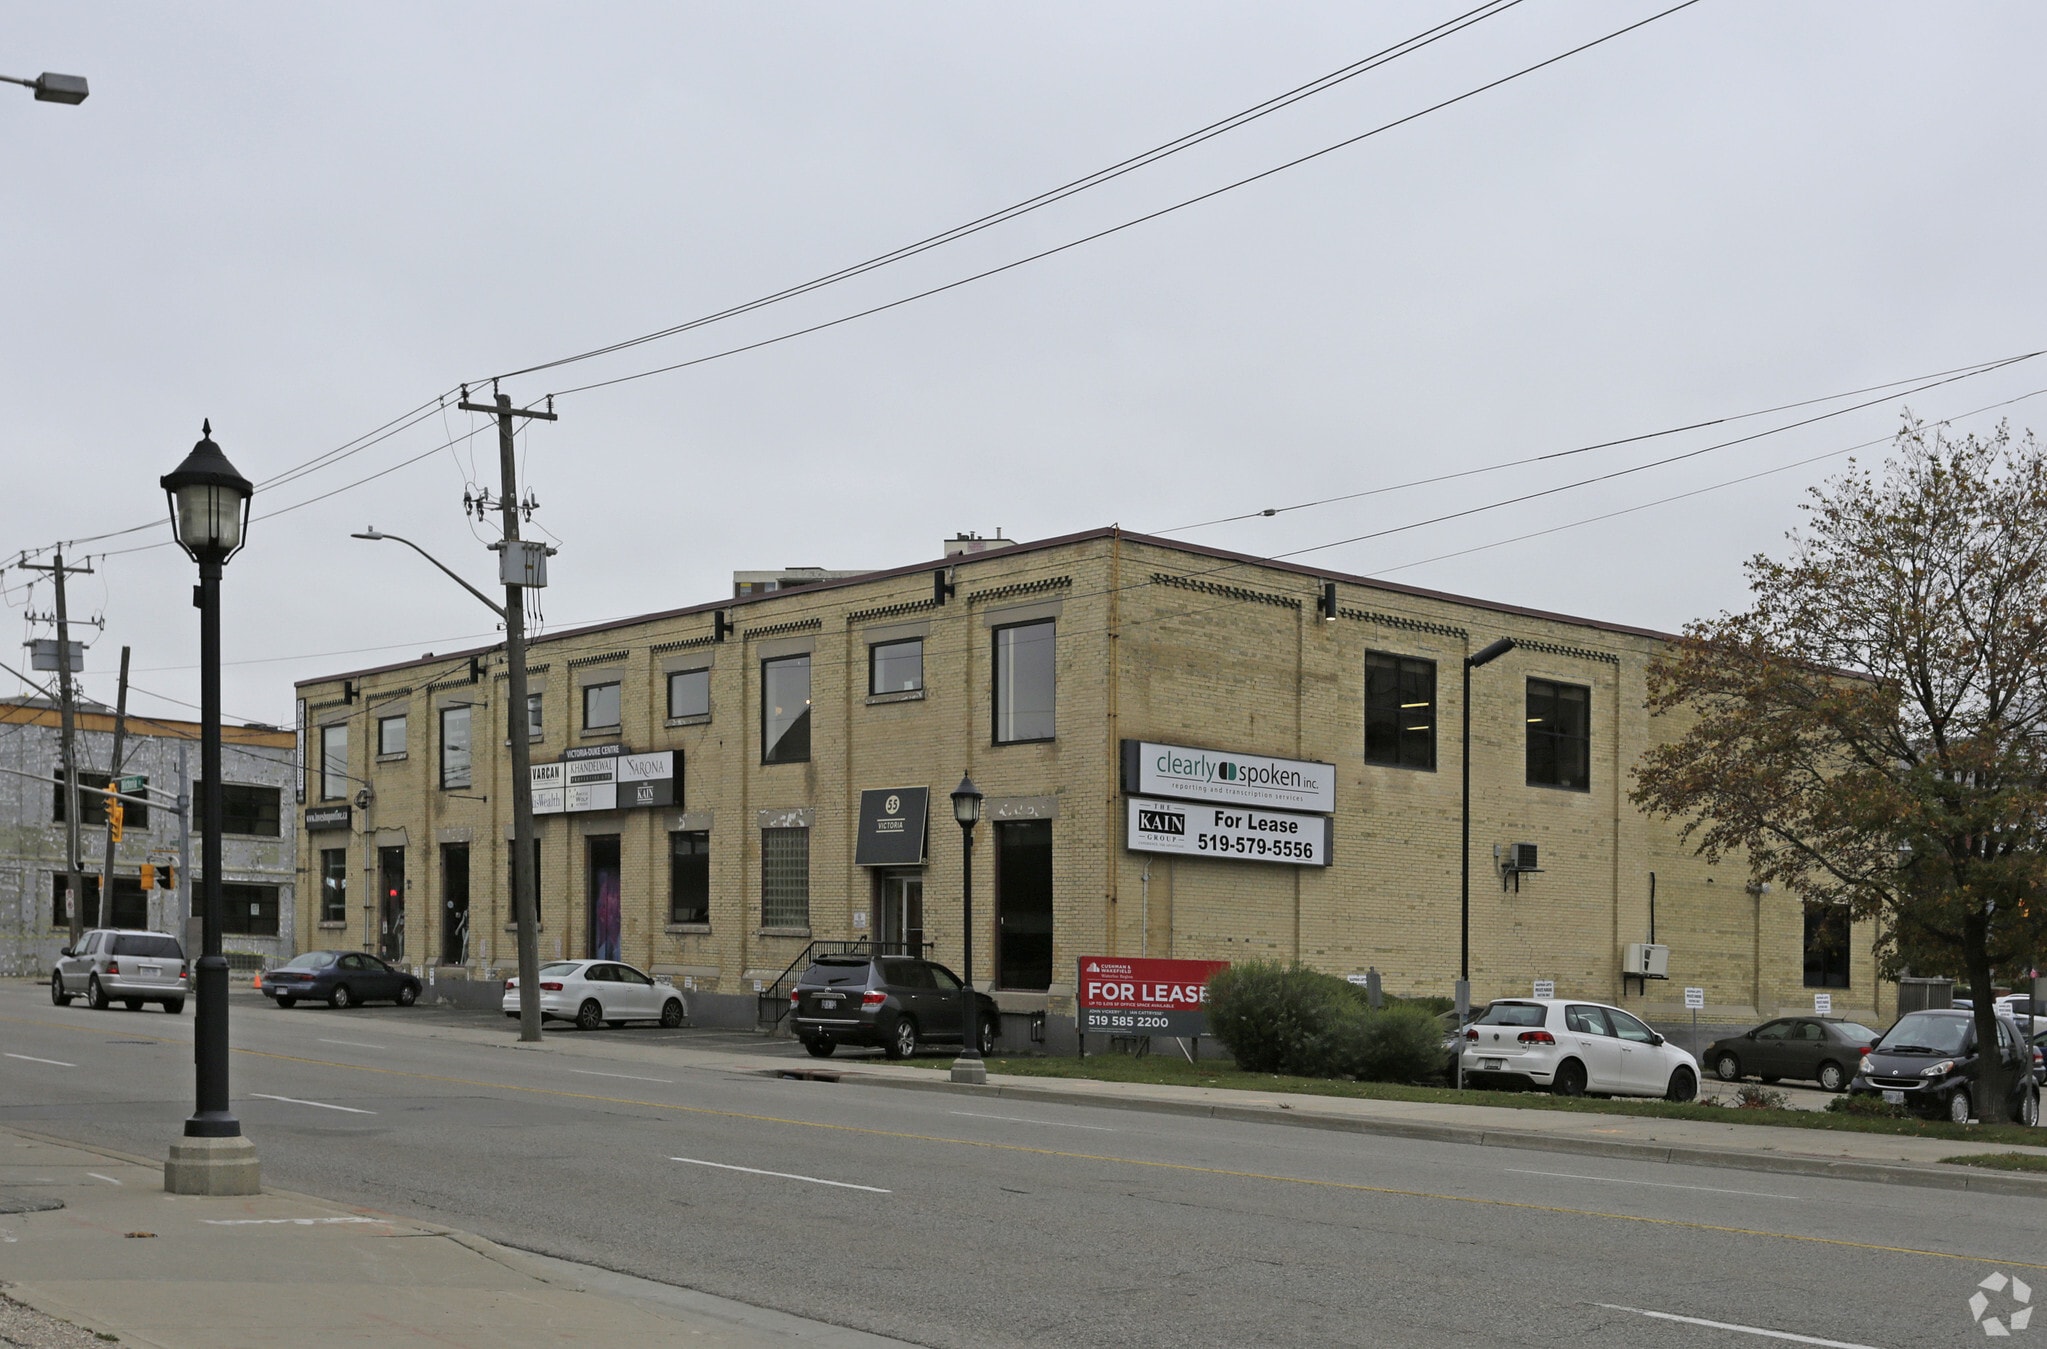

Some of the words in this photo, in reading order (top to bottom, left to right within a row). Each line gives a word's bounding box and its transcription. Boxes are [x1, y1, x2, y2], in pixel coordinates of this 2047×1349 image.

[566, 746, 601, 759] VICTORIA-DUKE
[601, 744, 620, 756] CENTRE
[532, 766, 560, 780] VARCAN
[571, 760, 612, 774] KHANDELWAL
[627, 757, 664, 778] SARONA
[1156, 750, 1217, 783] clearly
[1239, 763, 1301, 787] spoken
[1303, 777, 1319, 790] inc.
[637, 787, 654, 799] KAIN
[1172, 782, 1207, 794] reporting
[1209, 785, 1223, 795] and
[1225, 787, 1273, 800] transcription
[1275, 792, 1304, 802] services
[887, 799, 898, 810] 55
[1153, 803, 1171, 811] THE
[1140, 812, 1184, 833] KAIN
[1214, 810, 1242, 829] For
[1248, 813, 1298, 834] Lease
[1147, 834, 1177, 843] GROUP
[1197, 833, 1313, 860] 519-579-5556
[1088, 982, 1135, 1001] FOR
[1142, 984, 1210, 1003] LEASE
[1088, 1015, 1108, 1026] 519
[1112, 1016, 1134, 1026] 585
[1137, 1017, 1169, 1028] 2200
